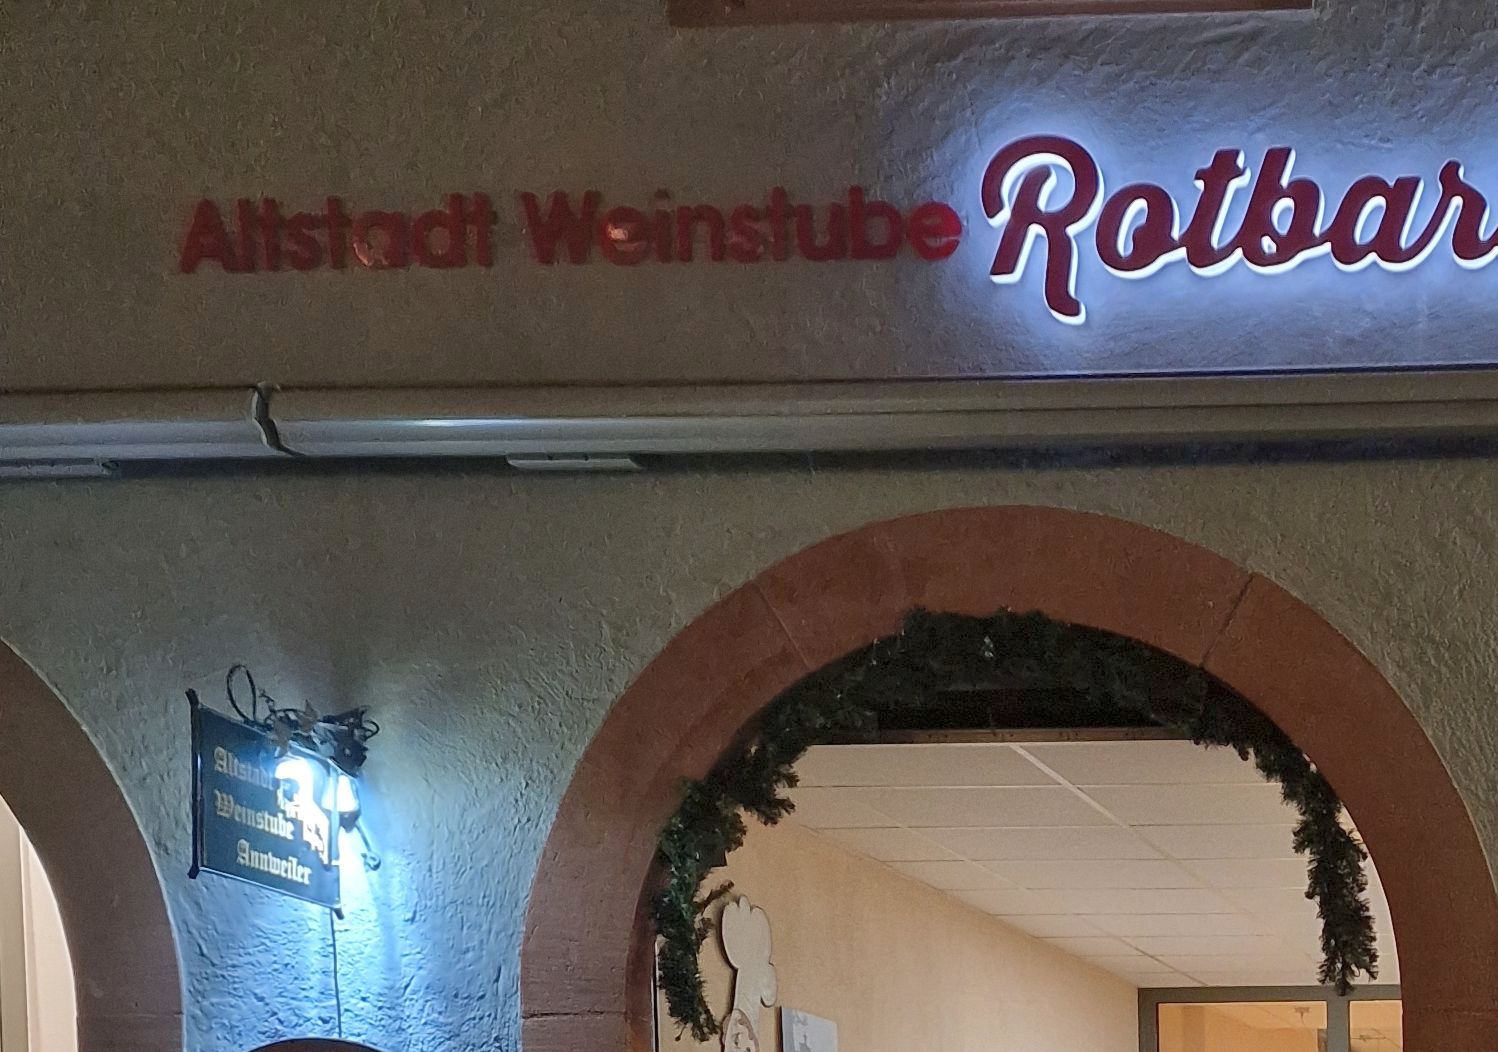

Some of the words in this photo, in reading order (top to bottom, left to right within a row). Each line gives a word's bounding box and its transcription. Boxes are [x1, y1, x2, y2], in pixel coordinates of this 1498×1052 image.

[180, 194, 498, 275] Altstadt
[520, 187, 964, 266] Weinstube
[213, 789, 295, 840] Weinstube
[236, 839, 313, 885] Annweiler
